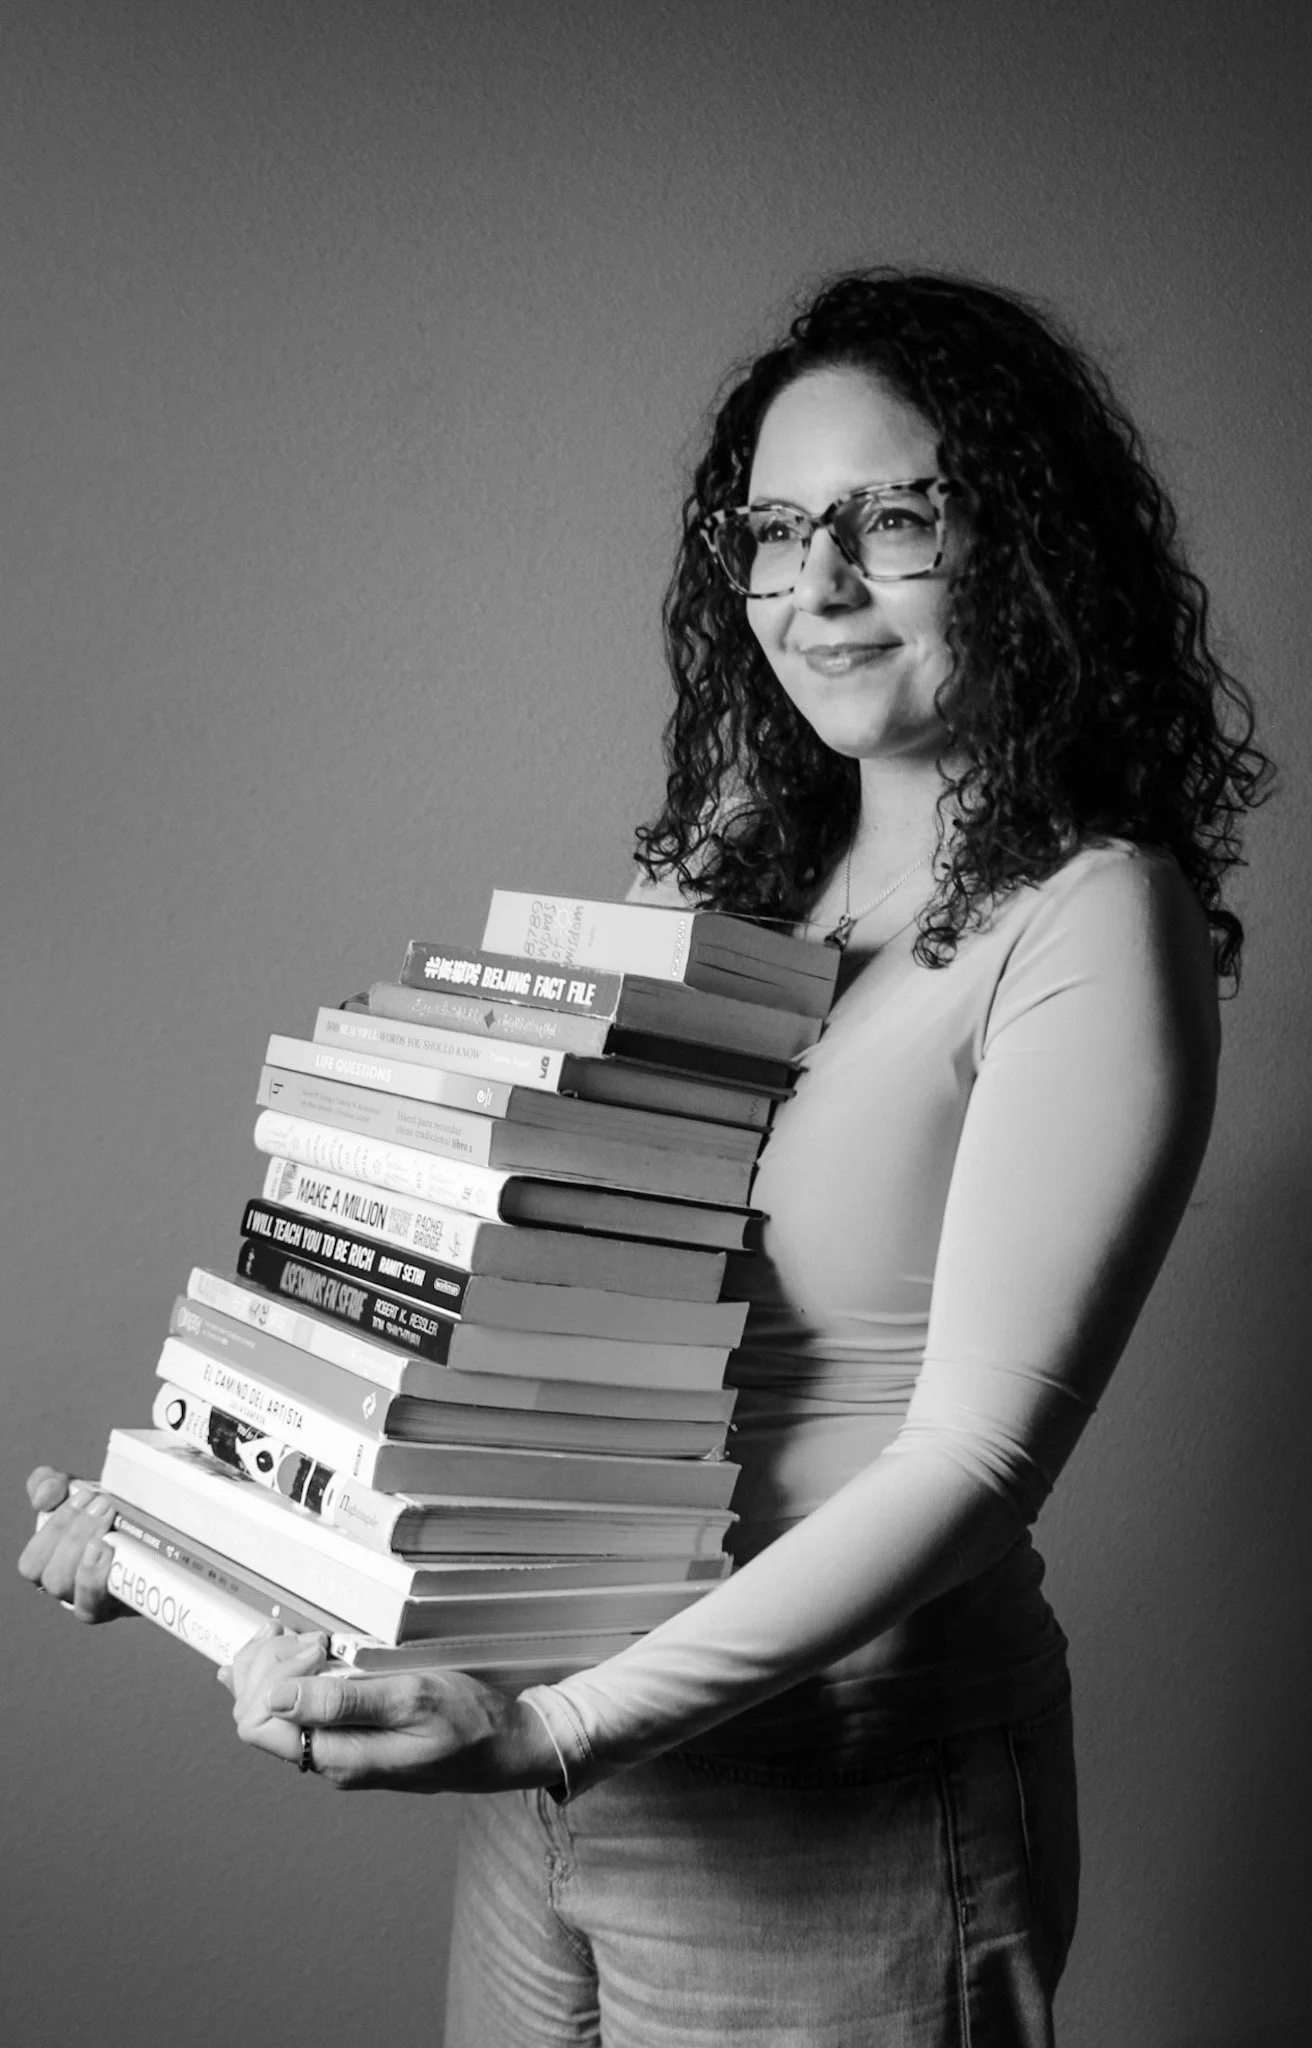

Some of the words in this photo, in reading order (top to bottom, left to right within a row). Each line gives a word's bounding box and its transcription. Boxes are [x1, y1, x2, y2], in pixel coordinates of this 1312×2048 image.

[481, 965, 532, 997] BEIJING
[533, 974, 567, 1002] FACT
[566, 980, 598, 1007] FILE
[379, 1031, 406, 1049] WORDS
[405, 1036, 423, 1051] YOU
[422, 1038, 455, 1058] SHOULD
[453, 1042, 482, 1061] KNOW
[314, 1053, 335, 1073] LIFE
[335, 1057, 393, 1085] QUESTIONS
[297, 1177, 331, 1210] MAKE
[330, 1190, 343, 1214] A
[342, 1190, 389, 1231] MILLION
[412, 1229, 441, 1252] BRIDGE
[415, 1213, 445, 1237] RACHEL
[246, 1208, 254, 1230] I
[252, 1215, 272, 1237] WILL
[272, 1218, 302, 1246] TEACH
[301, 1227, 323, 1253] YOU
[320, 1234, 336, 1259] TO
[333, 1238, 351, 1263] BE
[348, 1244, 376, 1272] RICH
[378, 1256, 405, 1280] RAMIT
[402, 1262, 427, 1287] SETHI
[373, 1297, 400, 1322] ROBERT
[408, 1311, 440, 1337] RESSLER
[203, 1363, 214, 1383] EL
[214, 1368, 249, 1401] CAMINO
[248, 1386, 266, 1411] DEL
[266, 1398, 304, 1432] ARTISTA
[107, 1560, 191, 1639] CHBOOK
